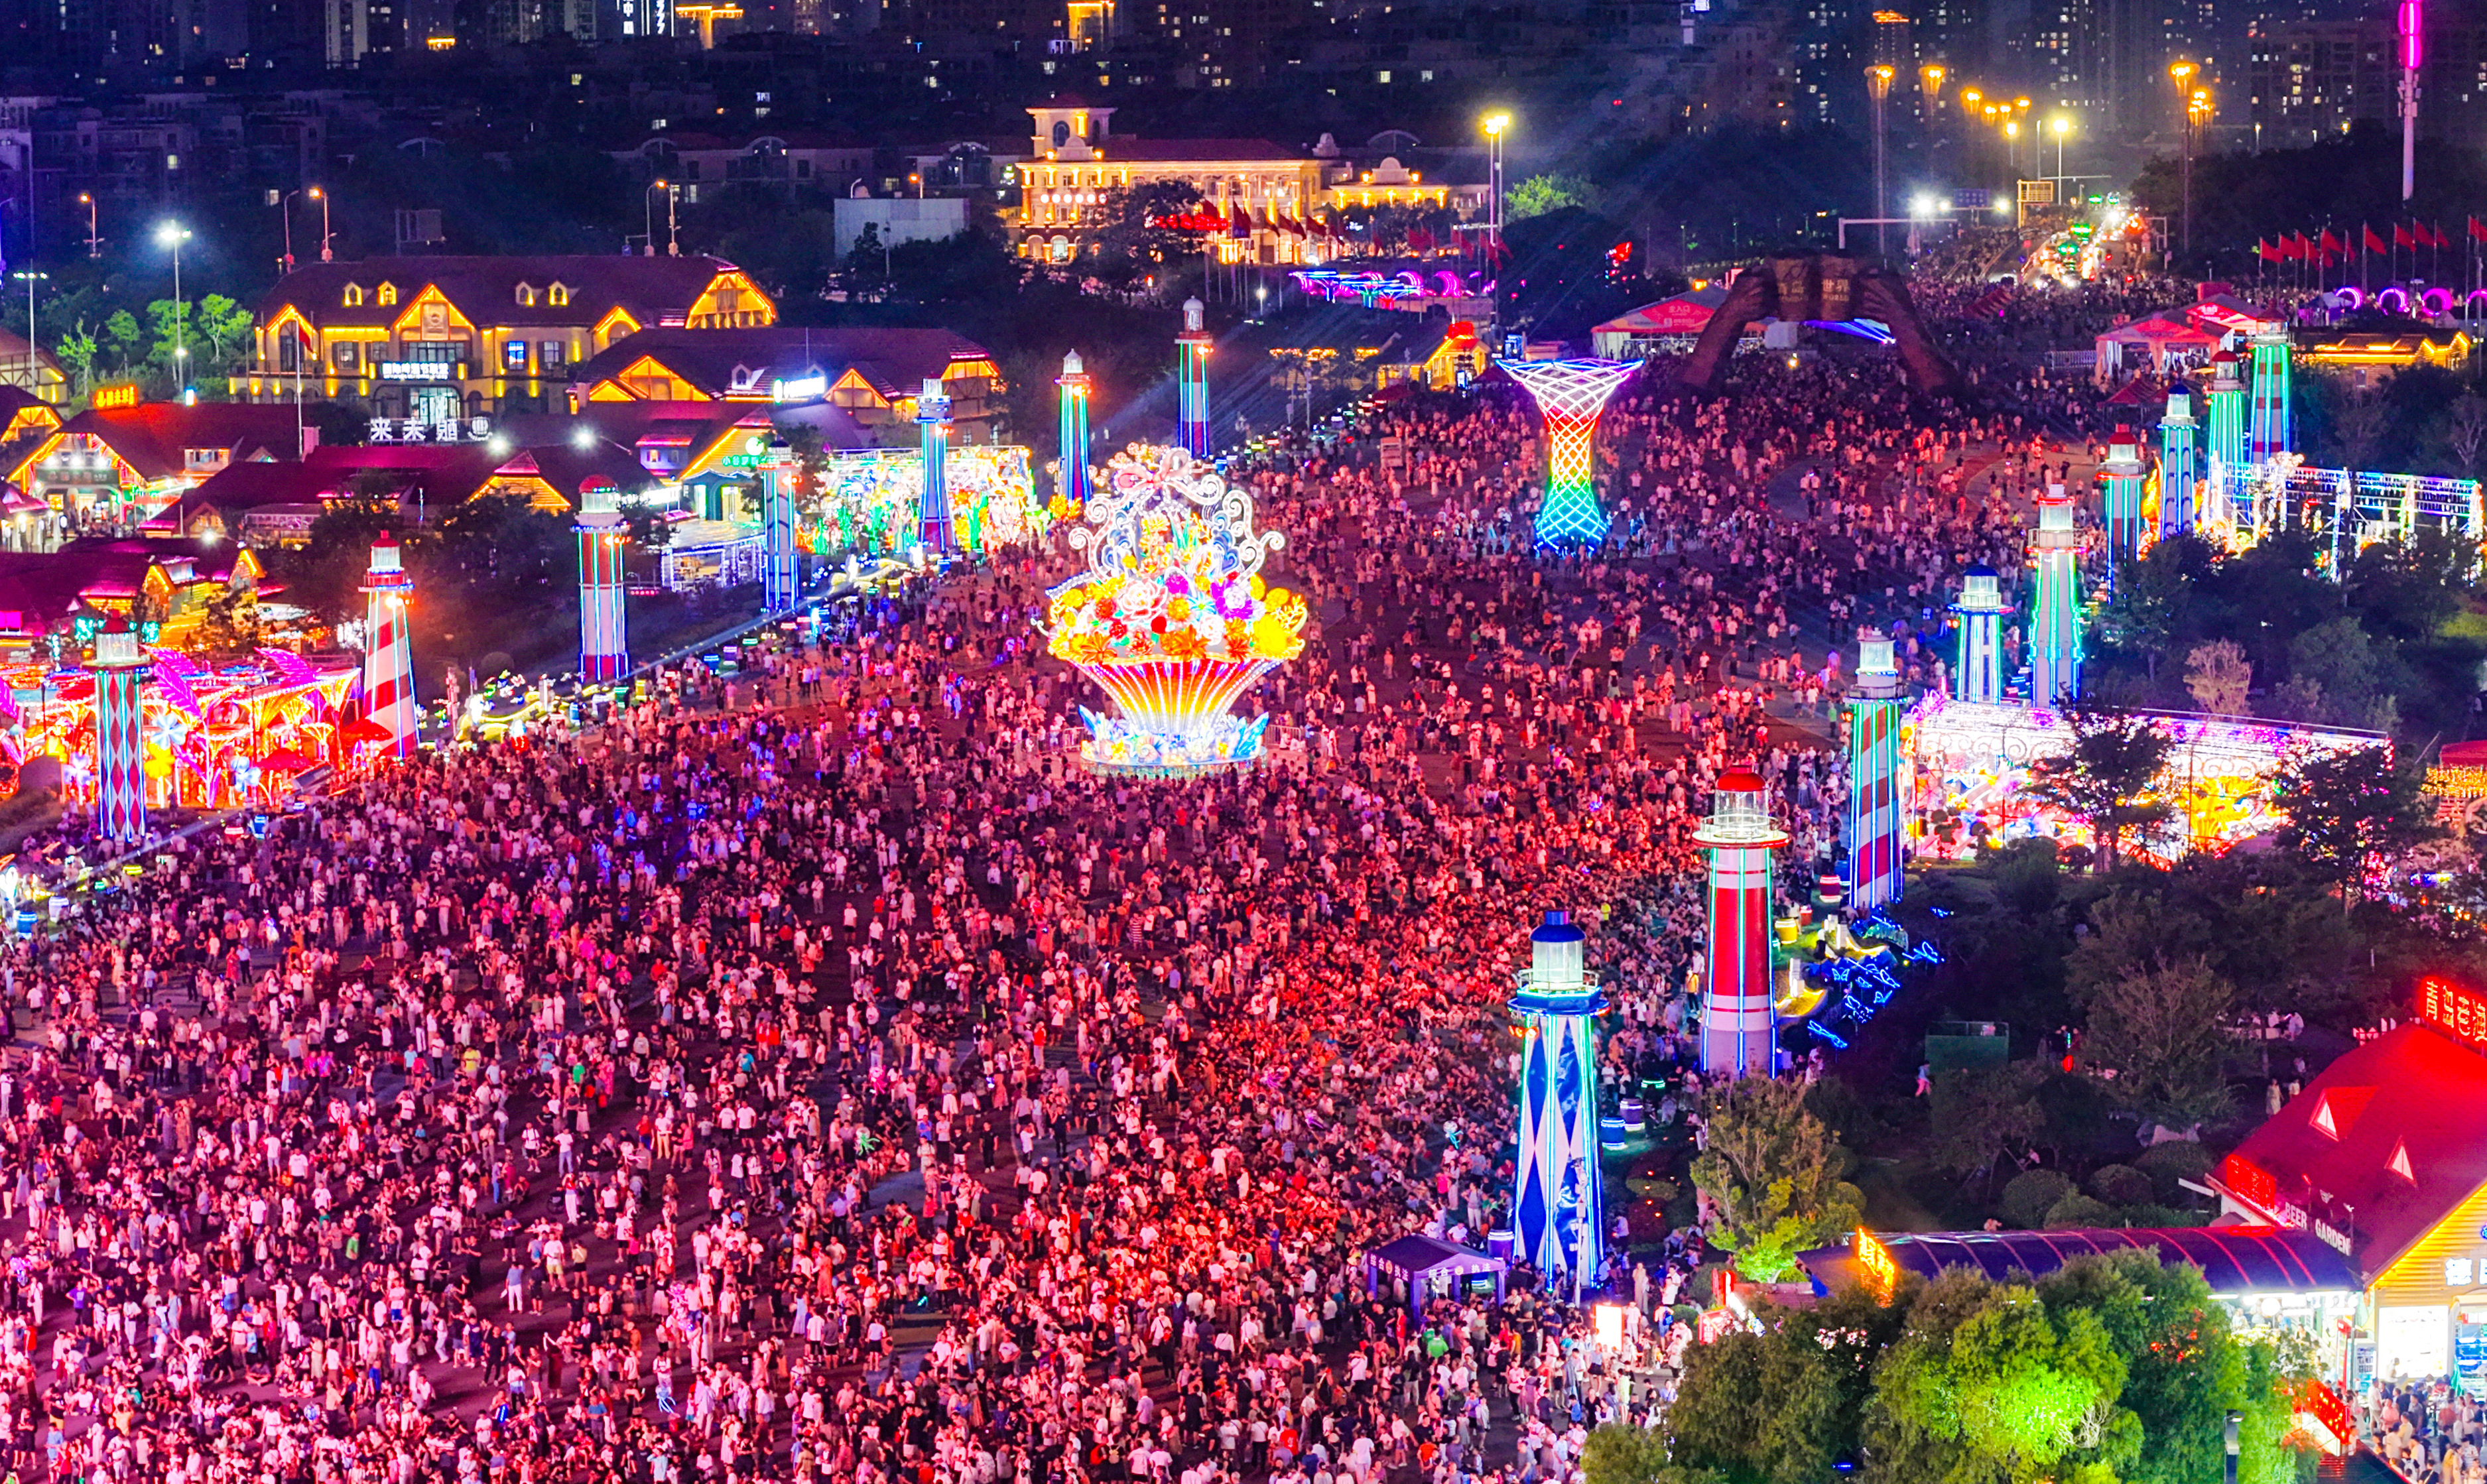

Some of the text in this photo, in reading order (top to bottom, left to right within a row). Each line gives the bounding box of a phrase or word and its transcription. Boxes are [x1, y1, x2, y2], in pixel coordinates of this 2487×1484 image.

[1822, 278, 1850, 293] 世界
[2285, 1201, 2352, 1257] BEER GARDEN
[1428, 1262, 1491, 1278] 综合 执法
[2445, 1258, 2487, 1286] 德
